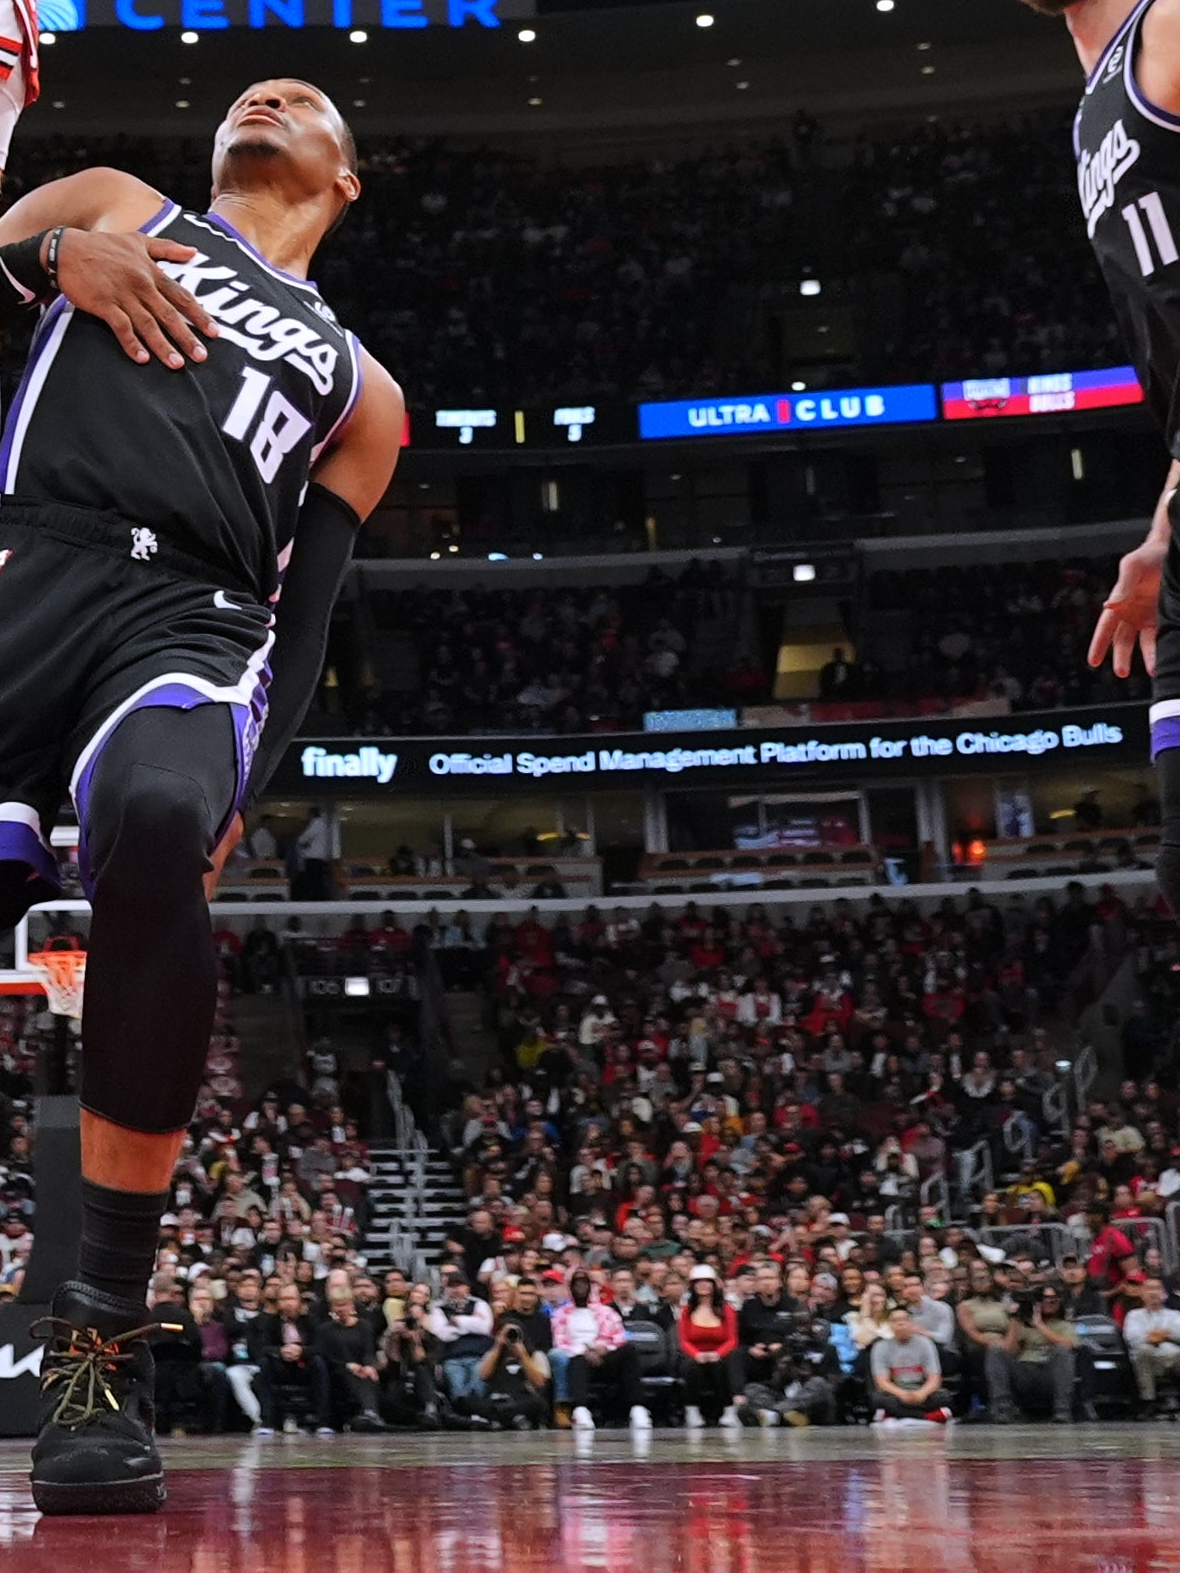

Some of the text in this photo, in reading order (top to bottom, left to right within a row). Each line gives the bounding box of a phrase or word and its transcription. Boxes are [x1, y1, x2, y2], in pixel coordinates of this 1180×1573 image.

[1121, 191, 1179, 277] 11
[156, 253, 334, 395] Kings
[222, 366, 311, 484] 18
[688, 394, 885, 427] ULTRA CLUB
[301, 747, 397, 783] finally
[429, 723, 1123, 777] Official Spend Management Platform for the Chicago Bulls
